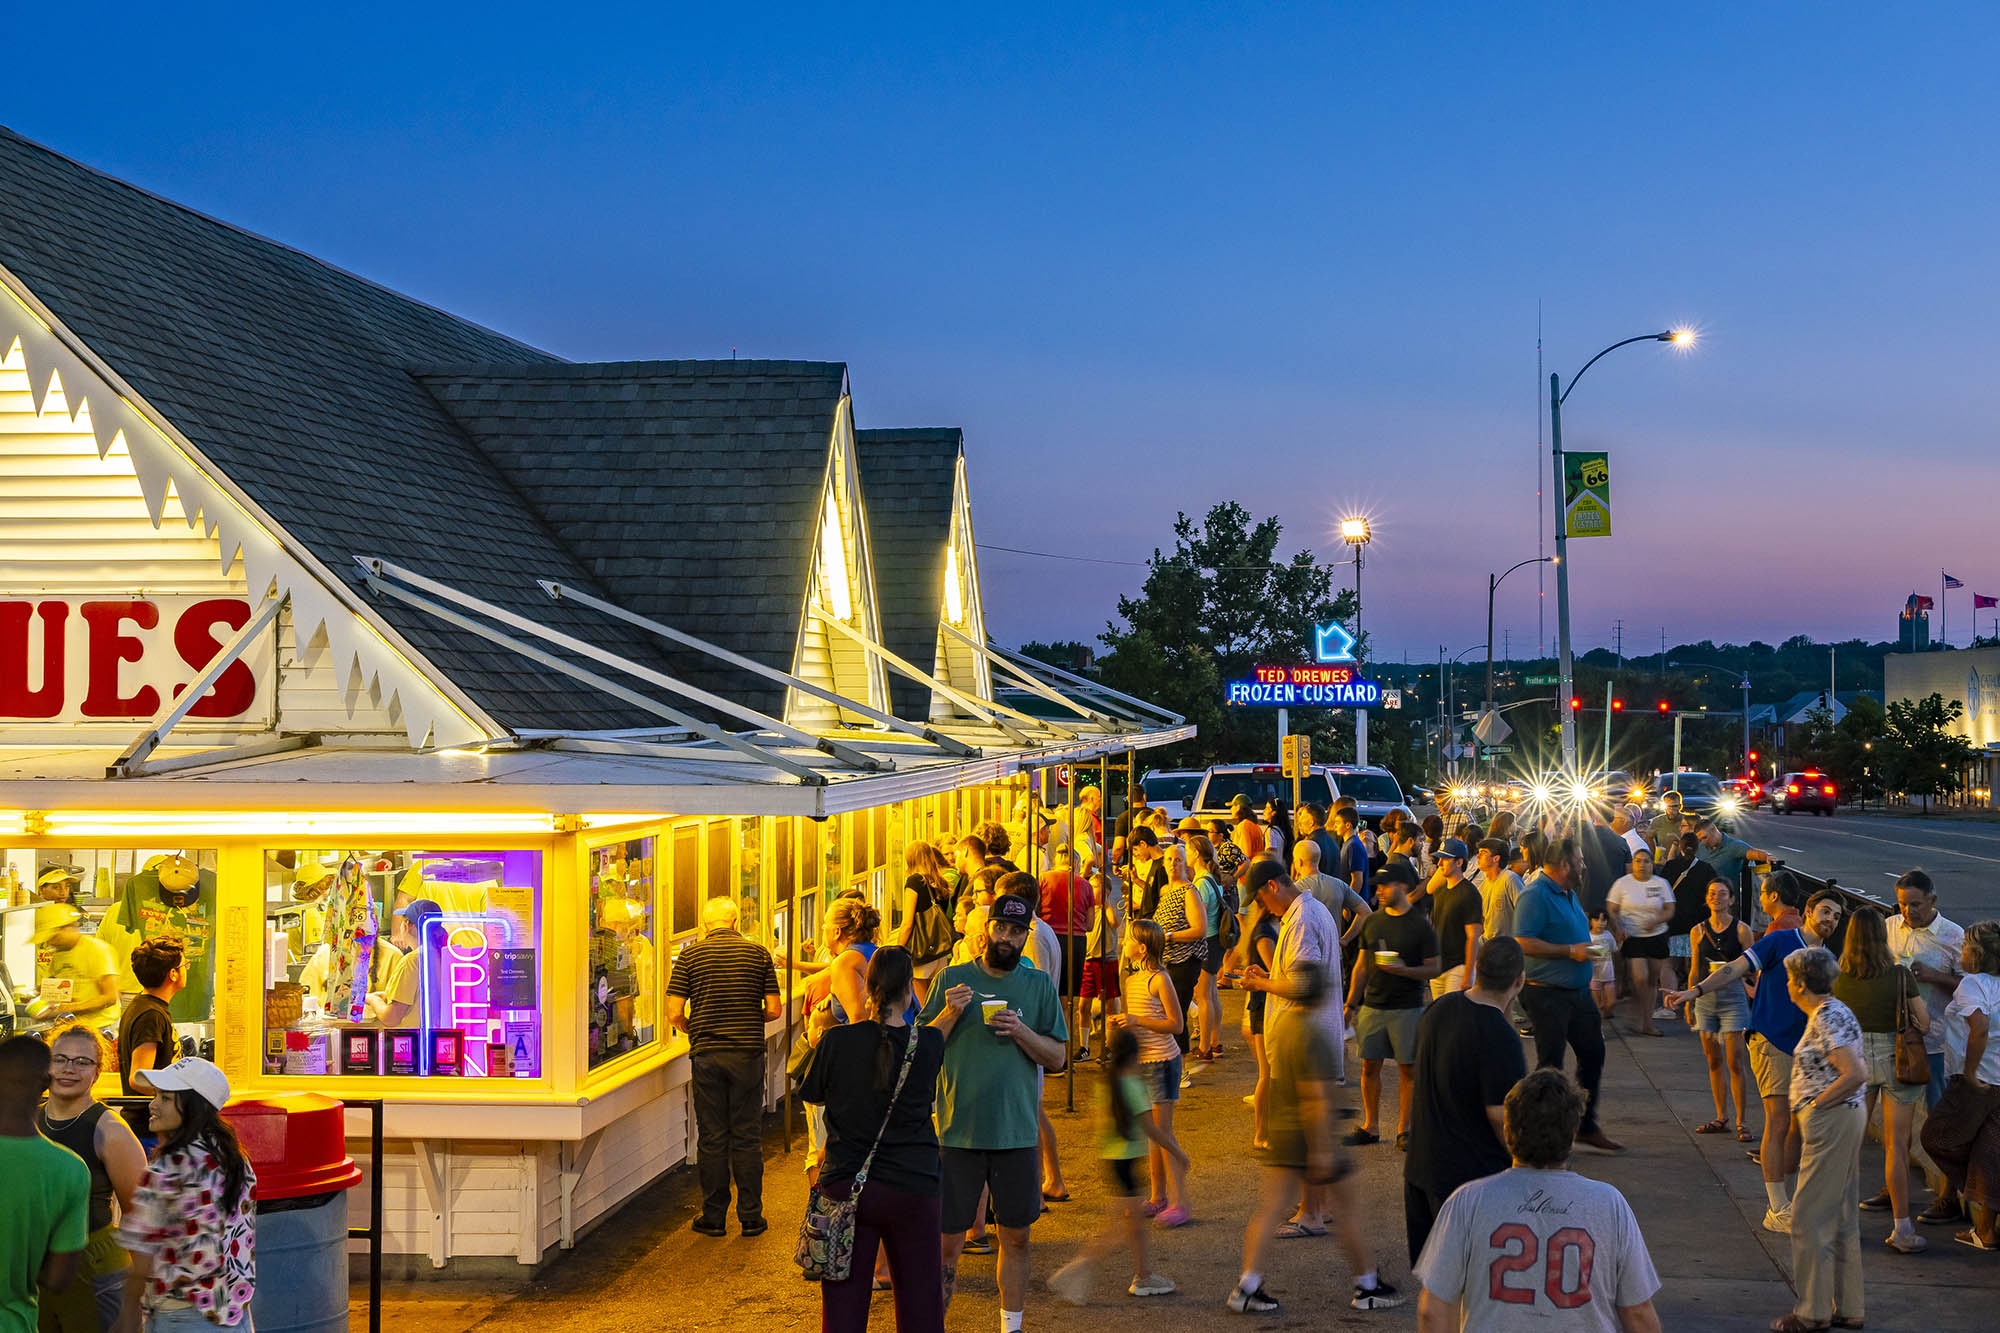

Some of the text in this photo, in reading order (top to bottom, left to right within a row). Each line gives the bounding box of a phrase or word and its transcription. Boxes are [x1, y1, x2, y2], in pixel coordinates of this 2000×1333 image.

[1587, 471, 1608, 485] 66
[1258, 670, 1349, 682] TED DREWES
[447, 927, 490, 1077] OPEN
[514, 1036, 528, 1056] A
[1489, 1222, 1595, 1309] 20
